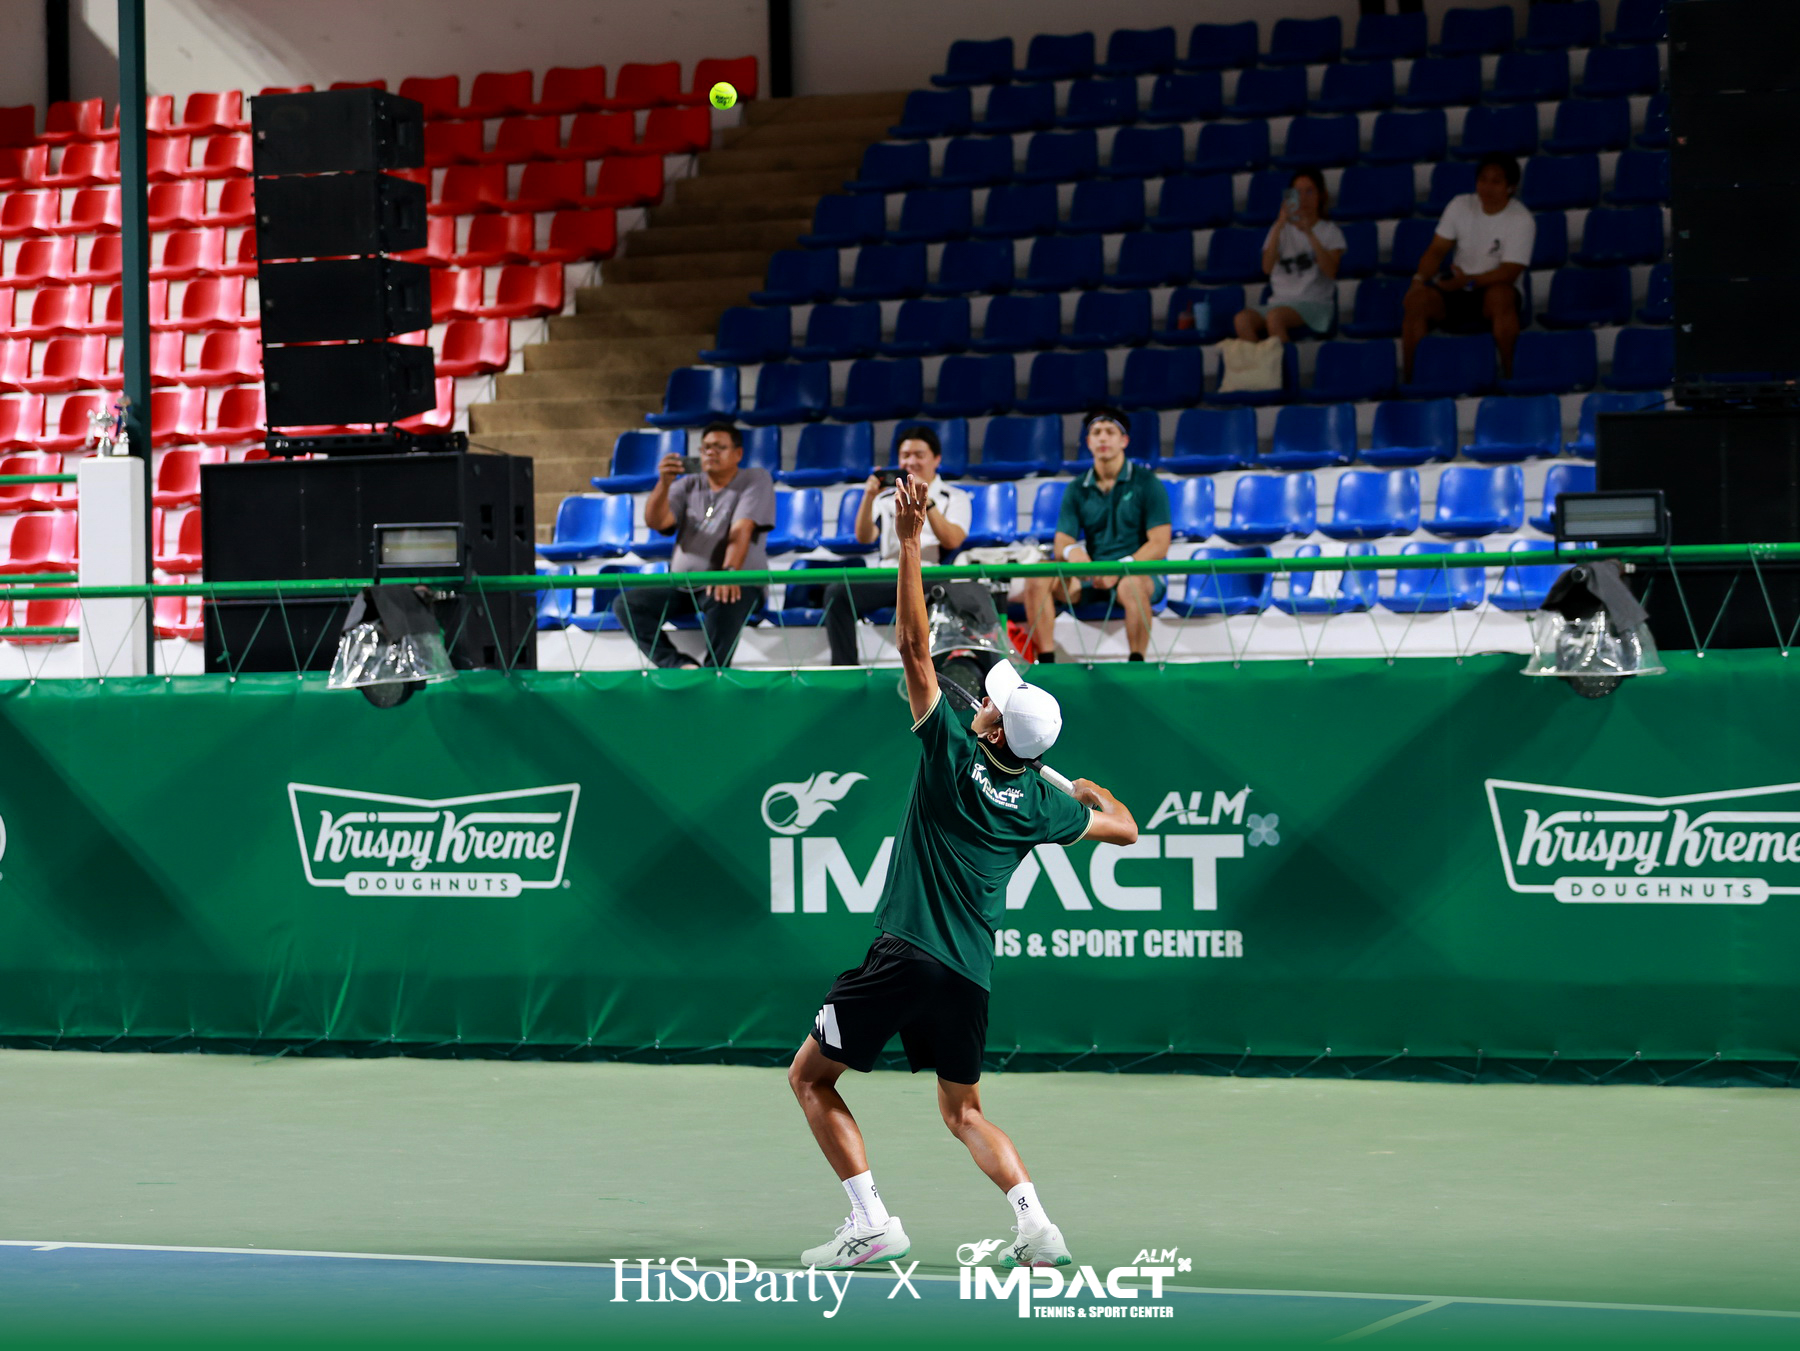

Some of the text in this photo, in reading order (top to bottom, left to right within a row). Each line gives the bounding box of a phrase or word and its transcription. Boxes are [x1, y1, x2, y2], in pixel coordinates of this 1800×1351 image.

[1145, 786, 1250, 830] ALM
[313, 810, 562, 871] Krispy Kreme
[1516, 809, 1800, 875] Krispy Kreme
[358, 876, 509, 892] DOUGHNUTS
[769, 834, 1245, 913] IMACT
[1570, 882, 1753, 898] DOUGHNUTS
[1026, 932, 1047, 957] &
[1051, 928, 1139, 958] SPORT
[1143, 929, 1244, 958] CENTER
